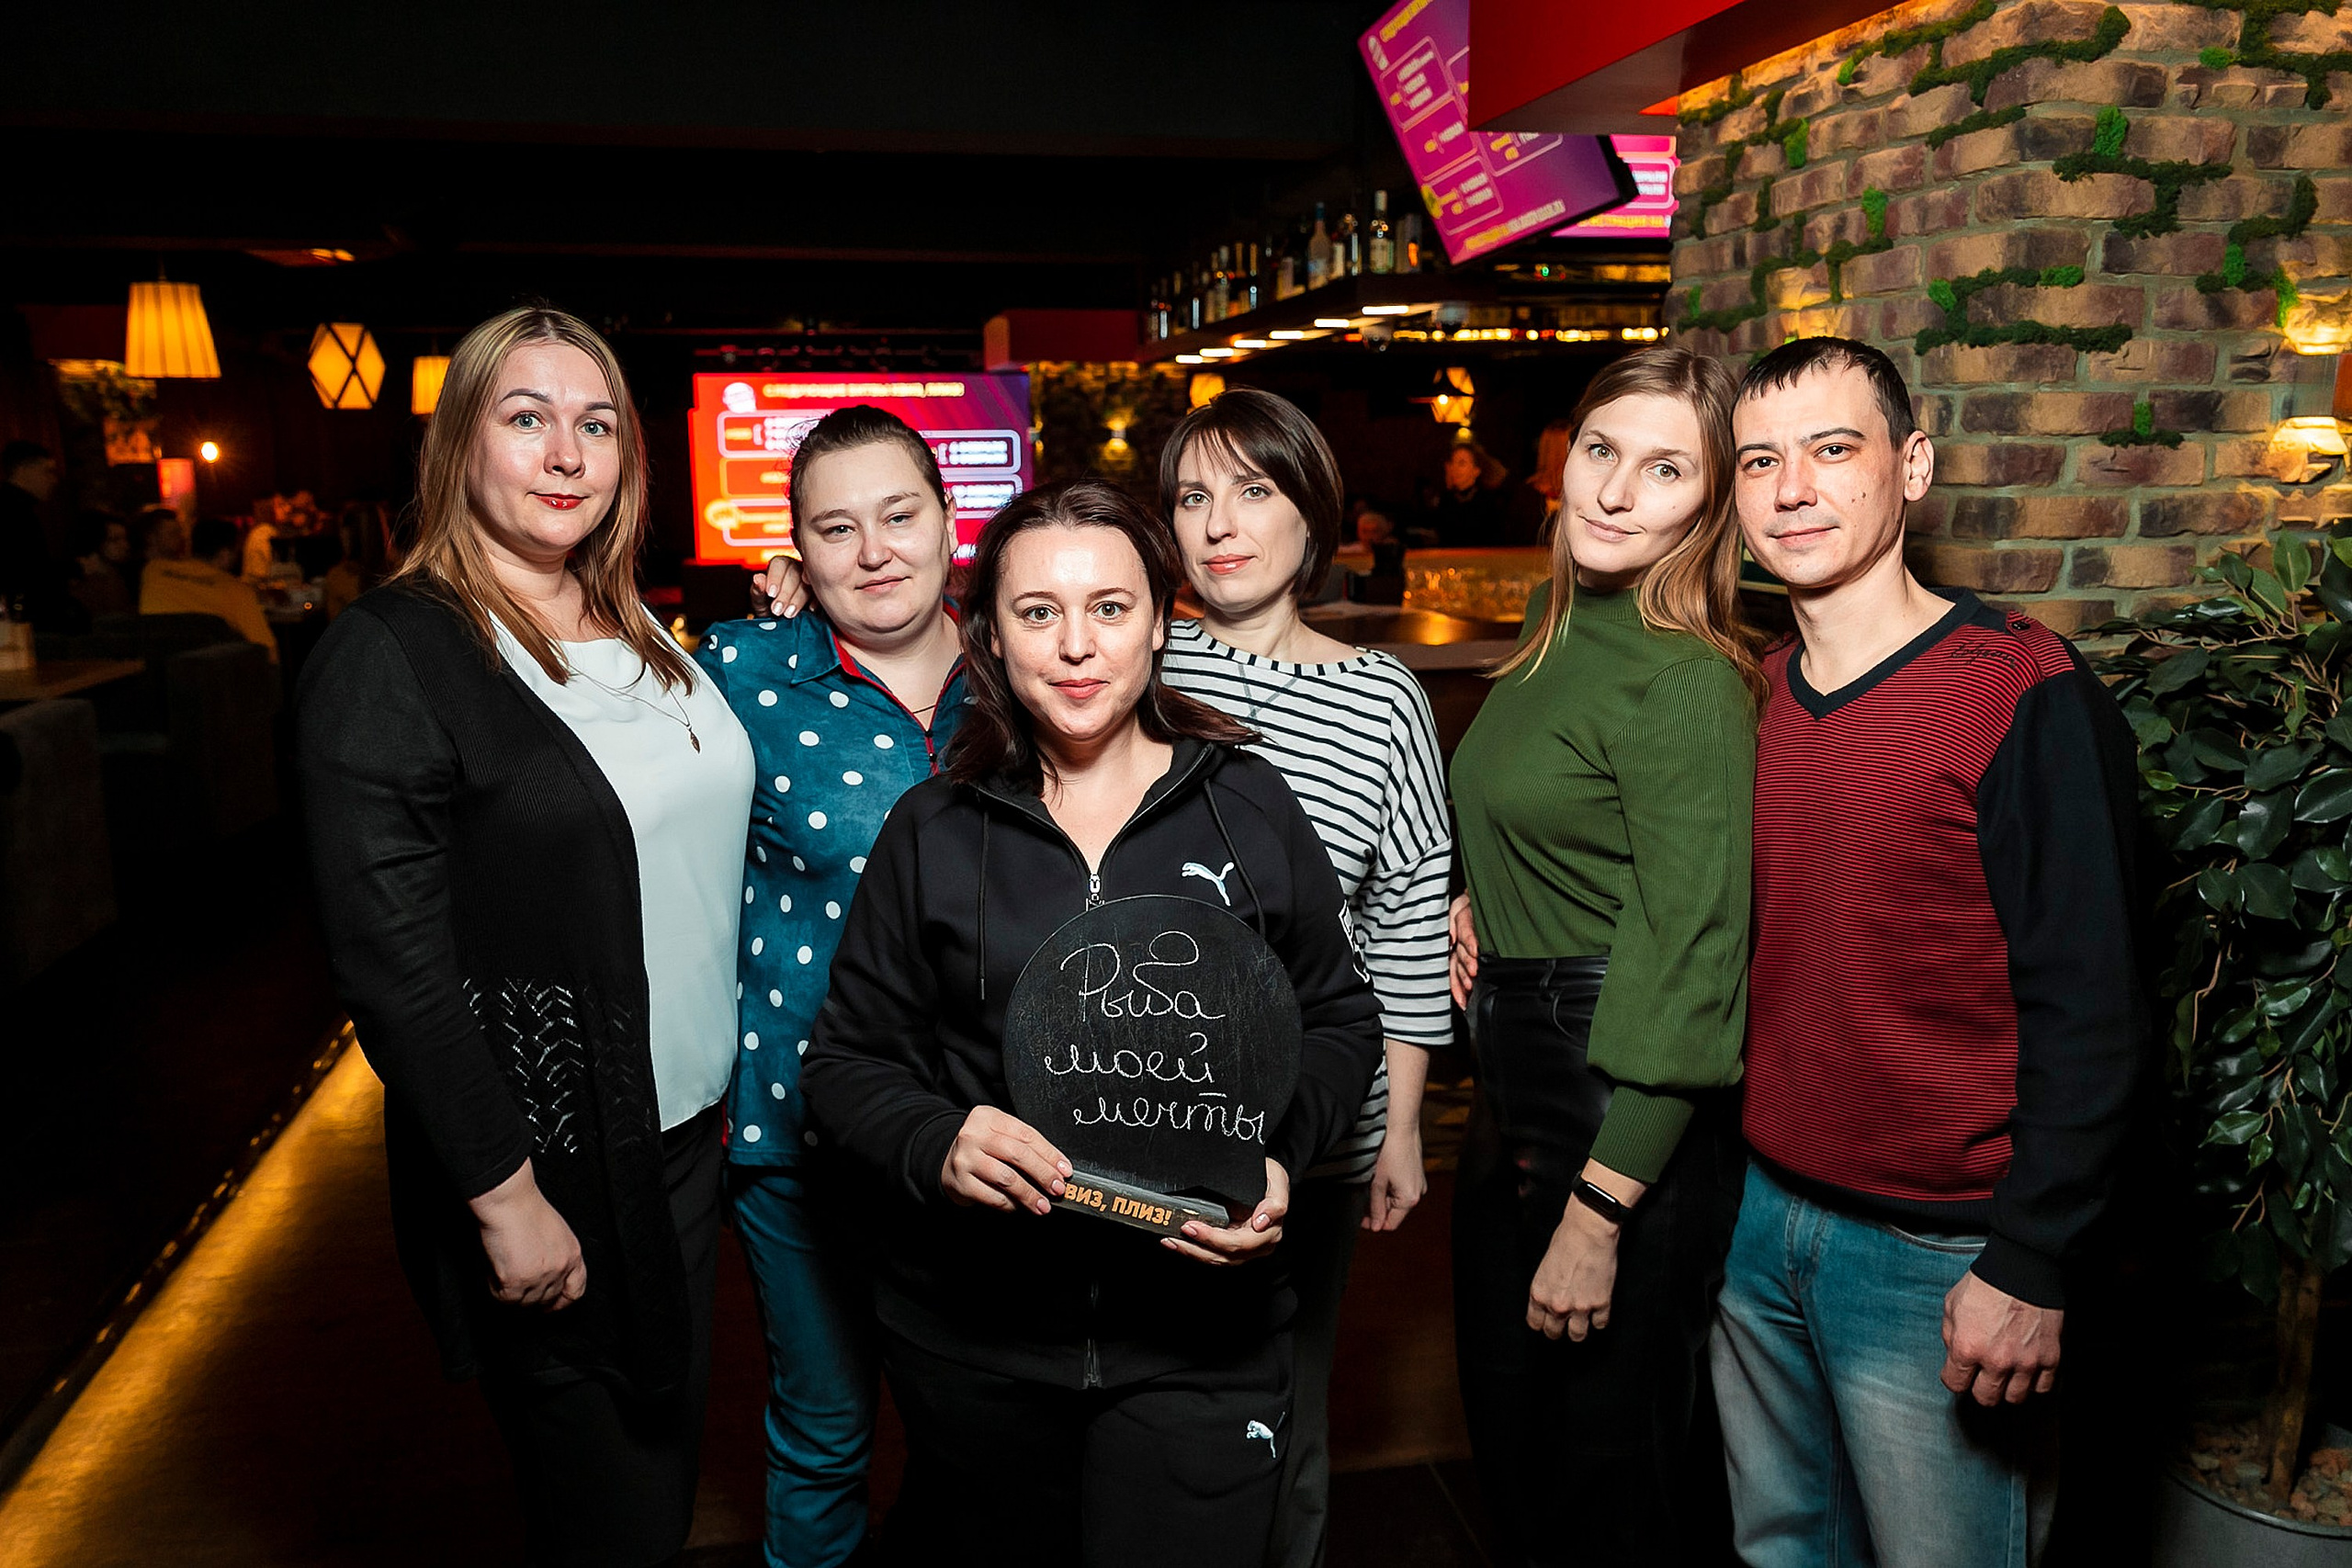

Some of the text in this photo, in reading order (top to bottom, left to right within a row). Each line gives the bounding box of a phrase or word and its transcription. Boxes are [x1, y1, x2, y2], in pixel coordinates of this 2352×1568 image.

[1060, 931, 1226, 1022] Рыба
[1044, 1032, 1216, 1084] моей
[1073, 1092, 1265, 1145] мечты
[1064, 1181, 1173, 1226] ВИЗ, ПЛИЗ!
